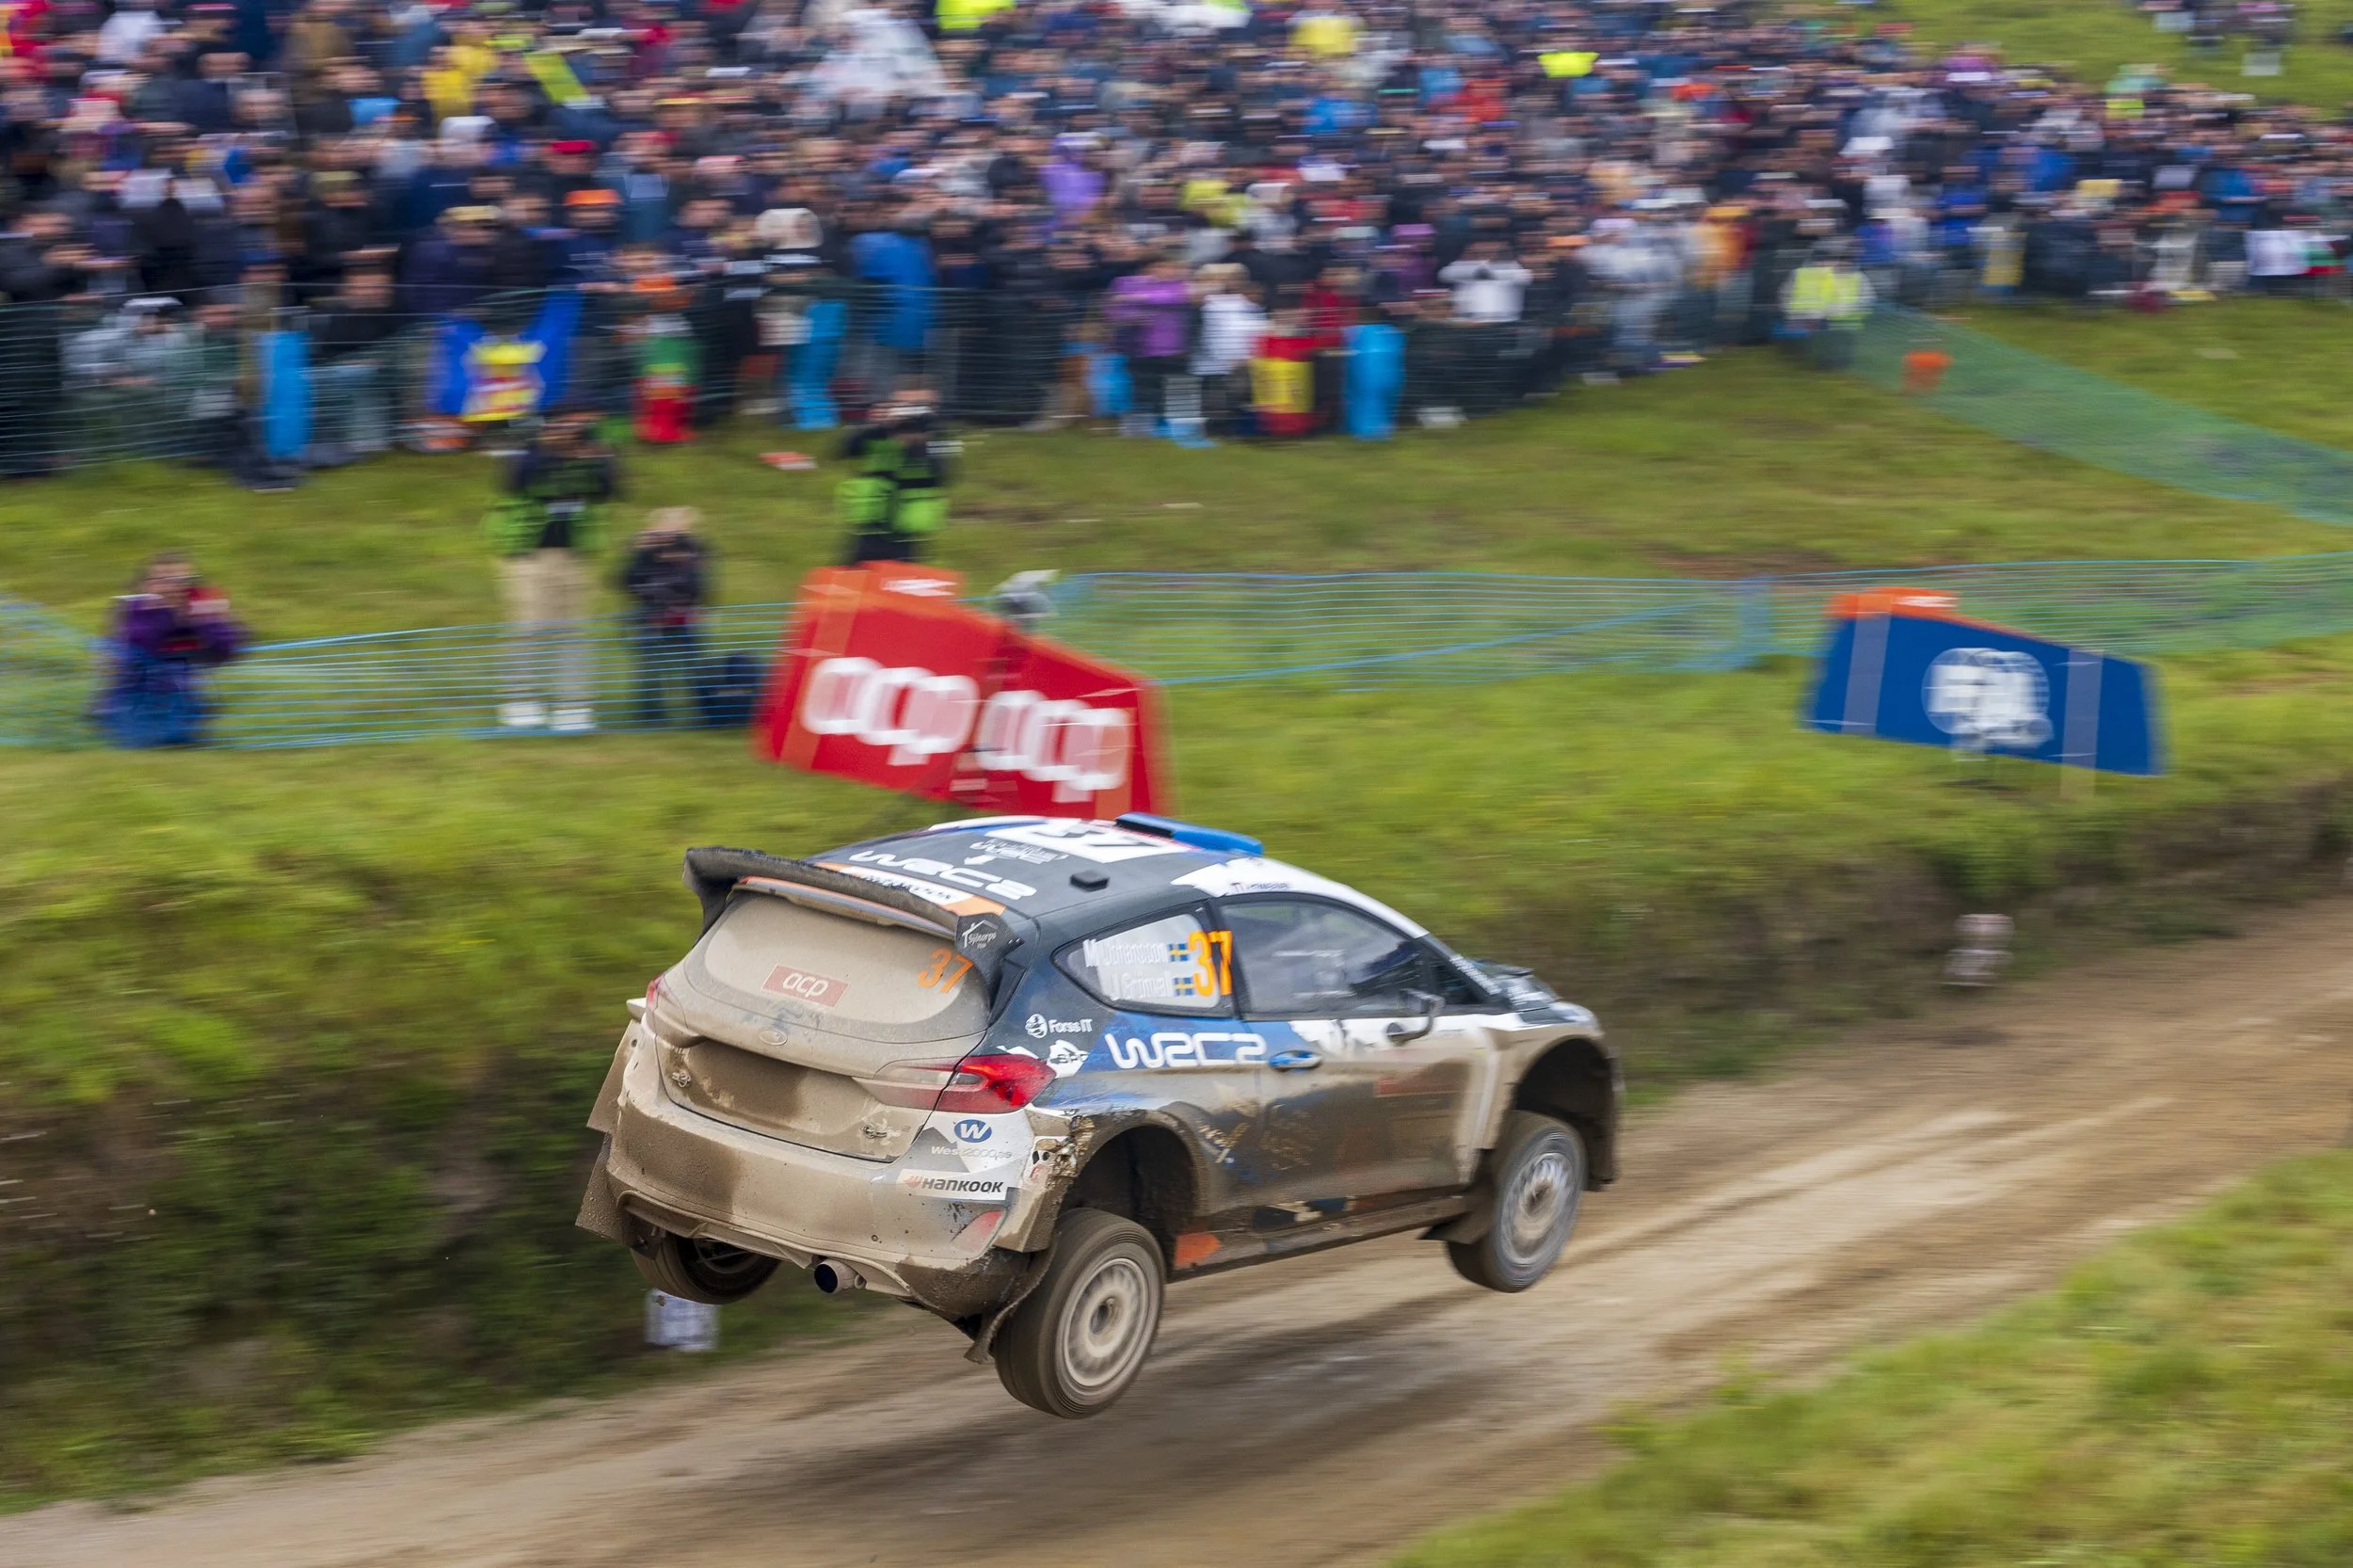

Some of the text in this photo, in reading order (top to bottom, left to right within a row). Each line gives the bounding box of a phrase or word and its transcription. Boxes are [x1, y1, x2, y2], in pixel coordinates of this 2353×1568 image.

[919, 949, 974, 994] 37
[1188, 930, 1233, 997] 37
[1104, 1032, 1268, 1069] WRC2
